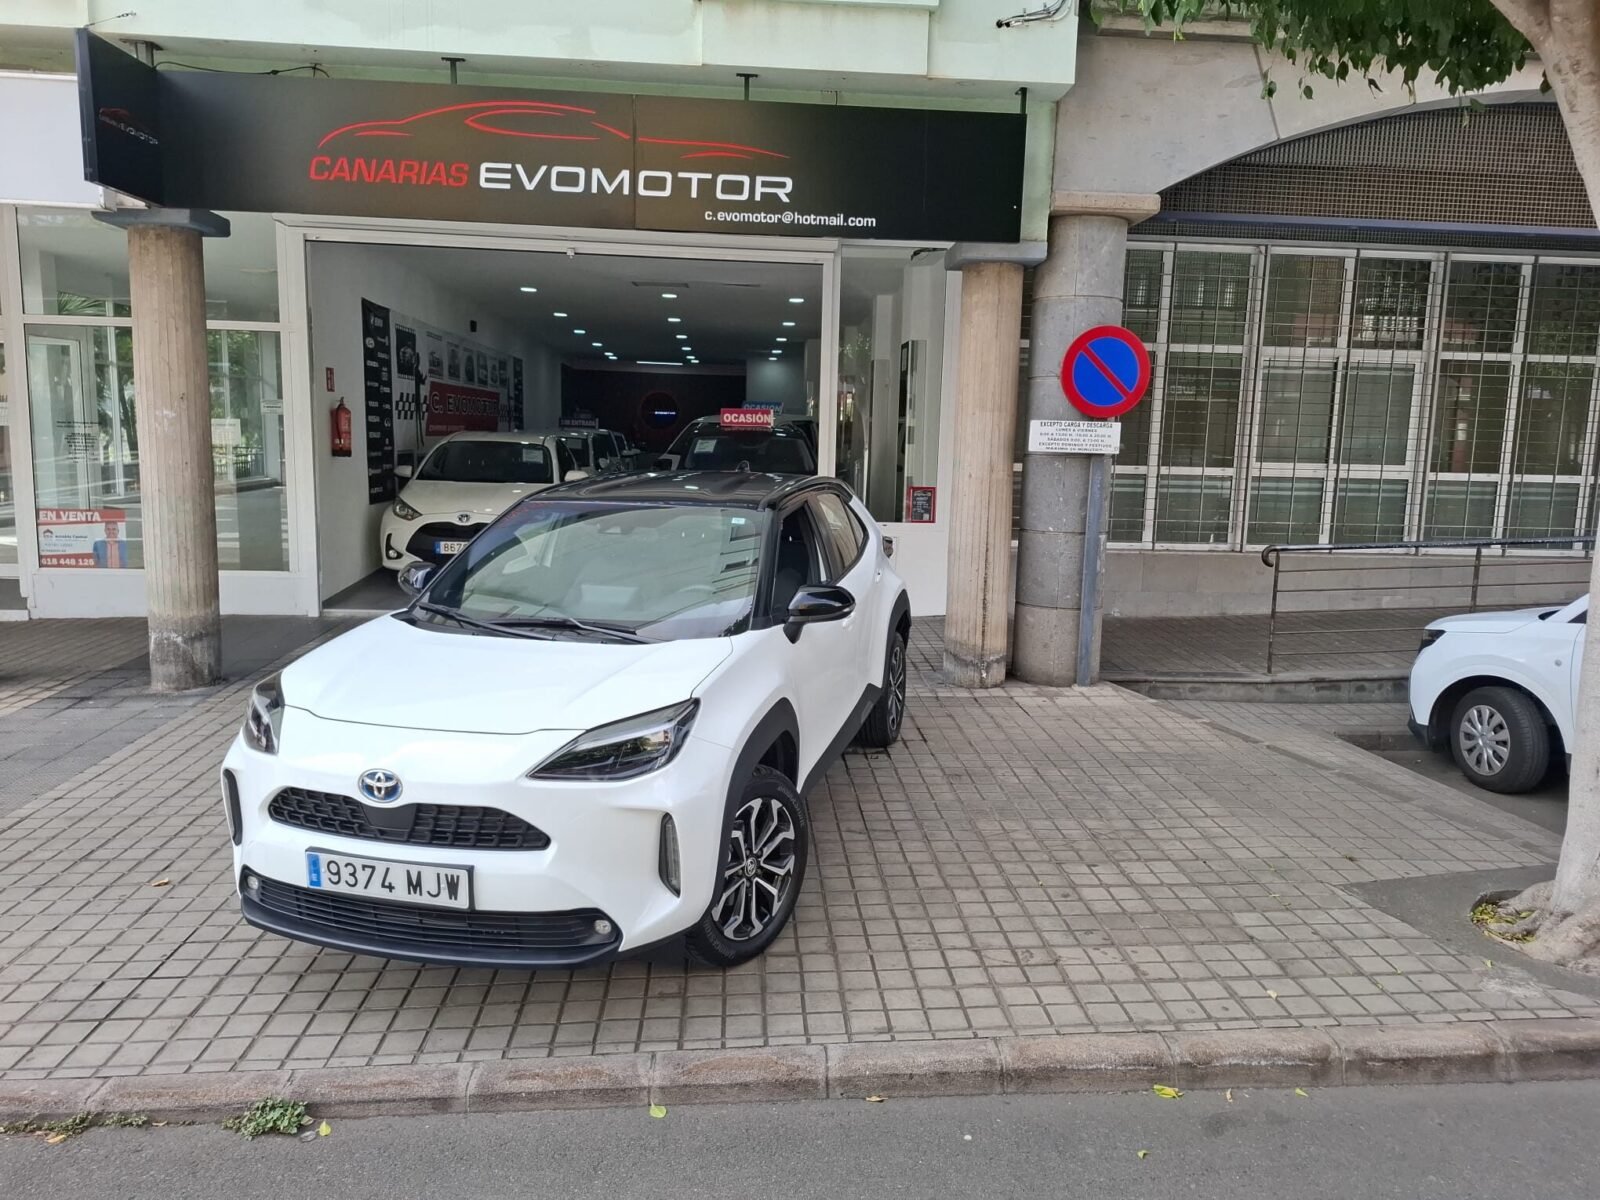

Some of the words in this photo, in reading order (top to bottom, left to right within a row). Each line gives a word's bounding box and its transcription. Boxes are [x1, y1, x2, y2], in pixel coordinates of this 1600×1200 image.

[308, 156, 470, 187] CANARIAS
[478, 161, 794, 203] EVOMOTOR
[704, 210, 877, 228] c.evomotor@hotmail.com
[723, 411, 772, 424] OCASIÓN
[39, 510, 56, 521] EN
[60, 511, 101, 522] VENTA
[326, 860, 395, 894] 9374
[406, 869, 460, 901] MJW
